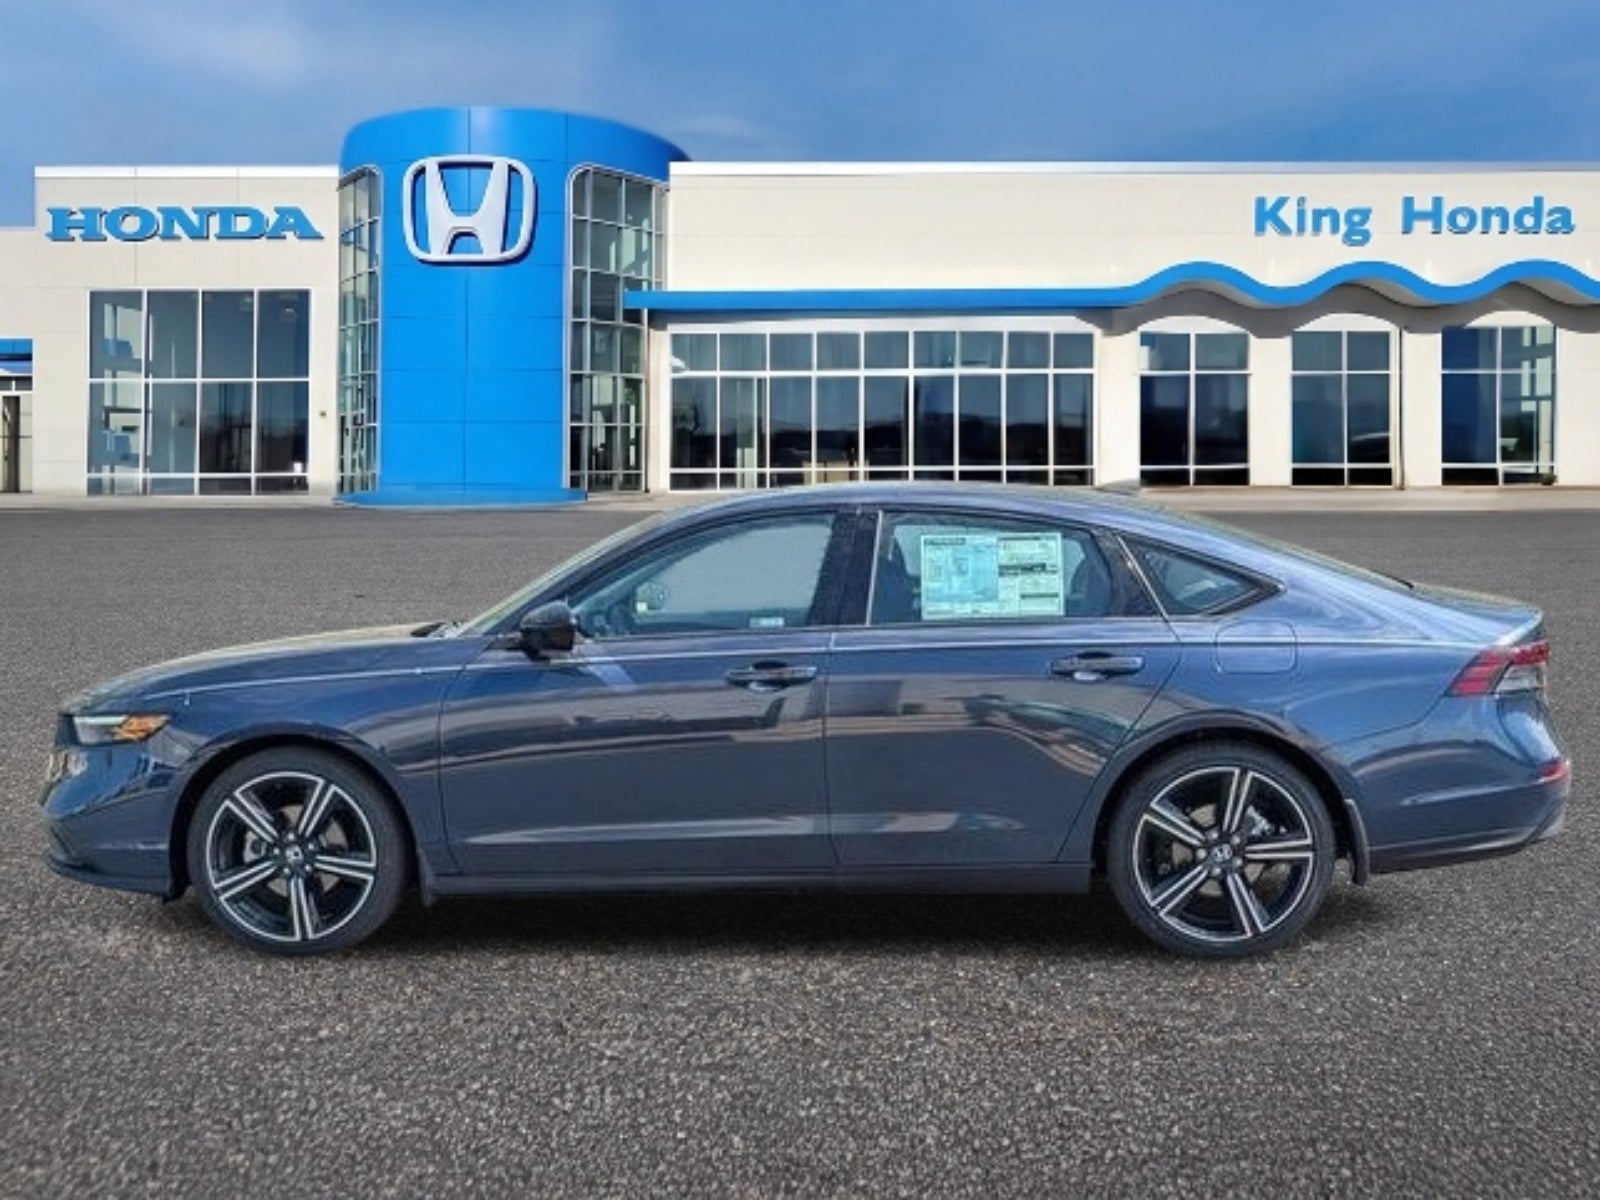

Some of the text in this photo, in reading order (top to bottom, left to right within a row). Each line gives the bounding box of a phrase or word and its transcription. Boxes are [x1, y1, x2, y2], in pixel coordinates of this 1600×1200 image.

[45, 206, 324, 242] HONDA
[1254, 196, 1576, 246] King Honda
